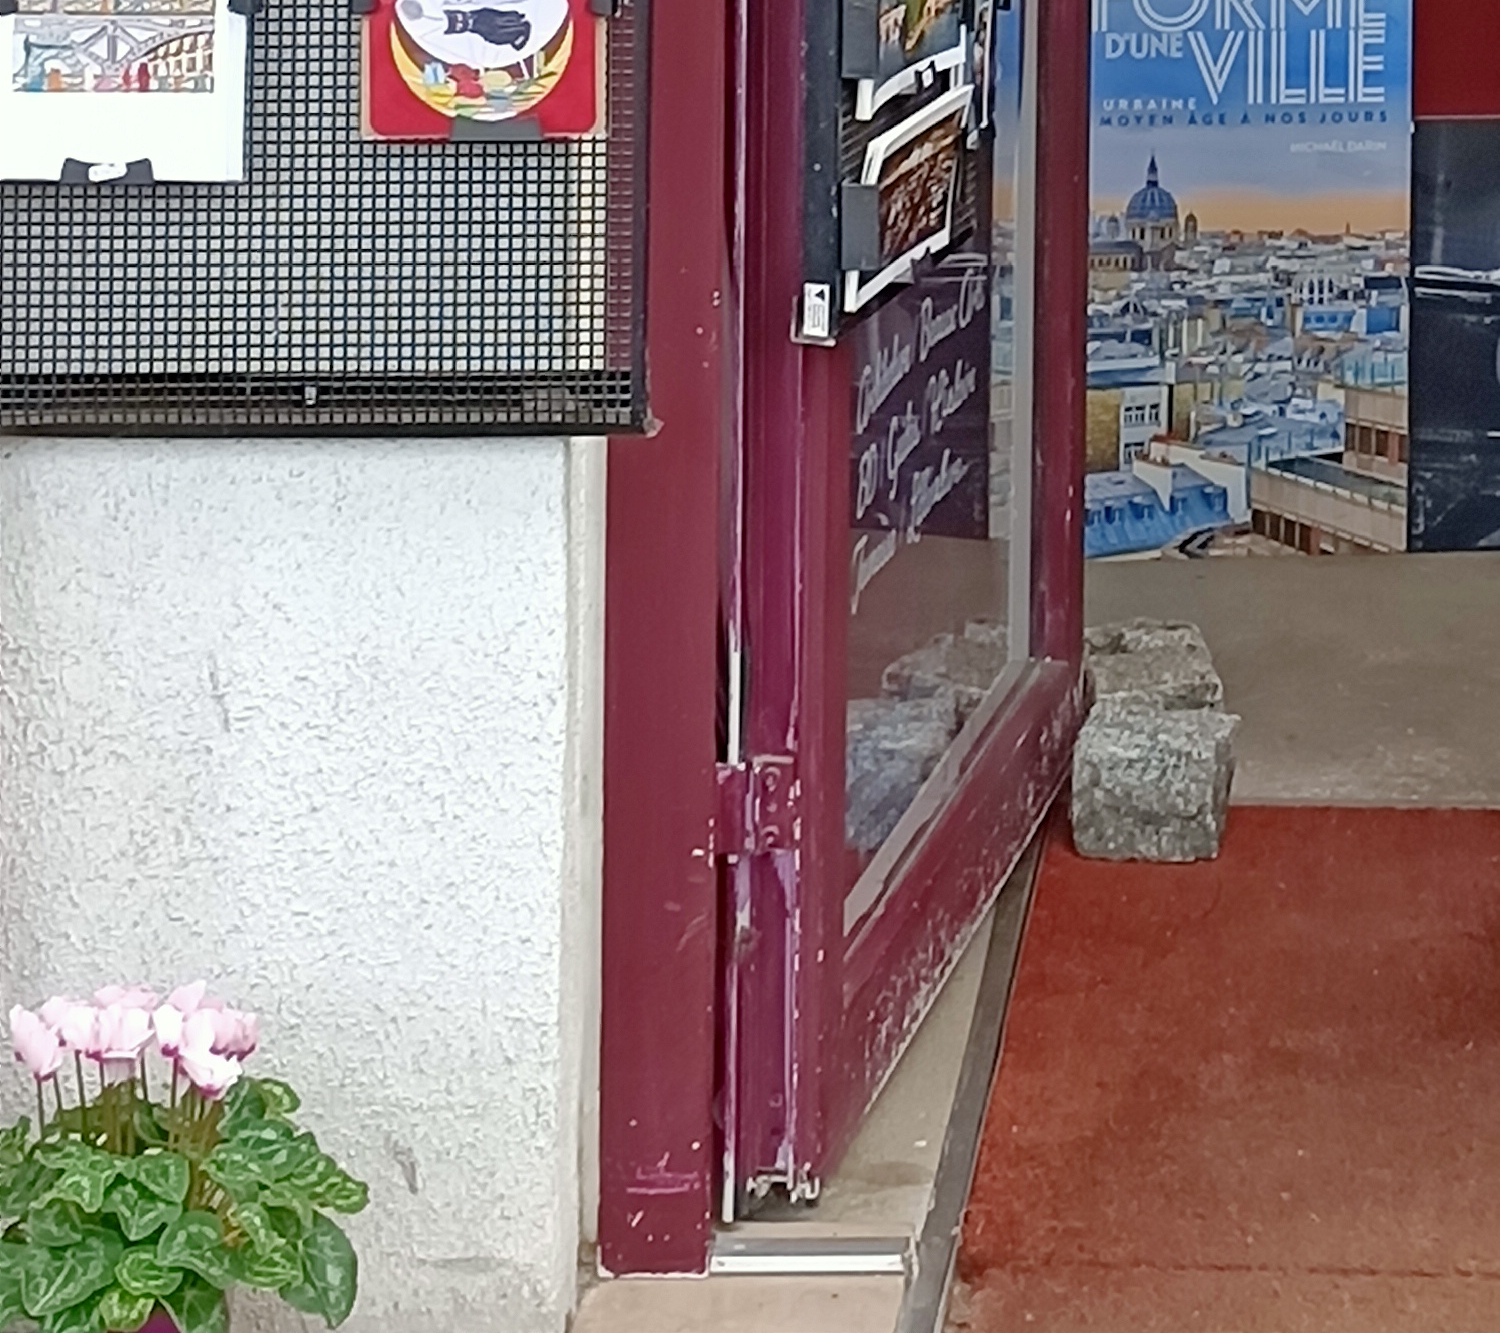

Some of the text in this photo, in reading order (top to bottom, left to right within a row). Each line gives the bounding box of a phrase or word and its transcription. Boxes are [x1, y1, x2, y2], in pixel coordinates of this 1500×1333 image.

[1104, 32, 1184, 59] D'UNE
[1186, 29, 1386, 106] VILLE
[1102, 98, 1197, 111] URBAINE
[1099, 115, 1174, 126] MOYEN
[1264, 110, 1307, 124] NOS
[1319, 109, 1389, 123] JOURS
